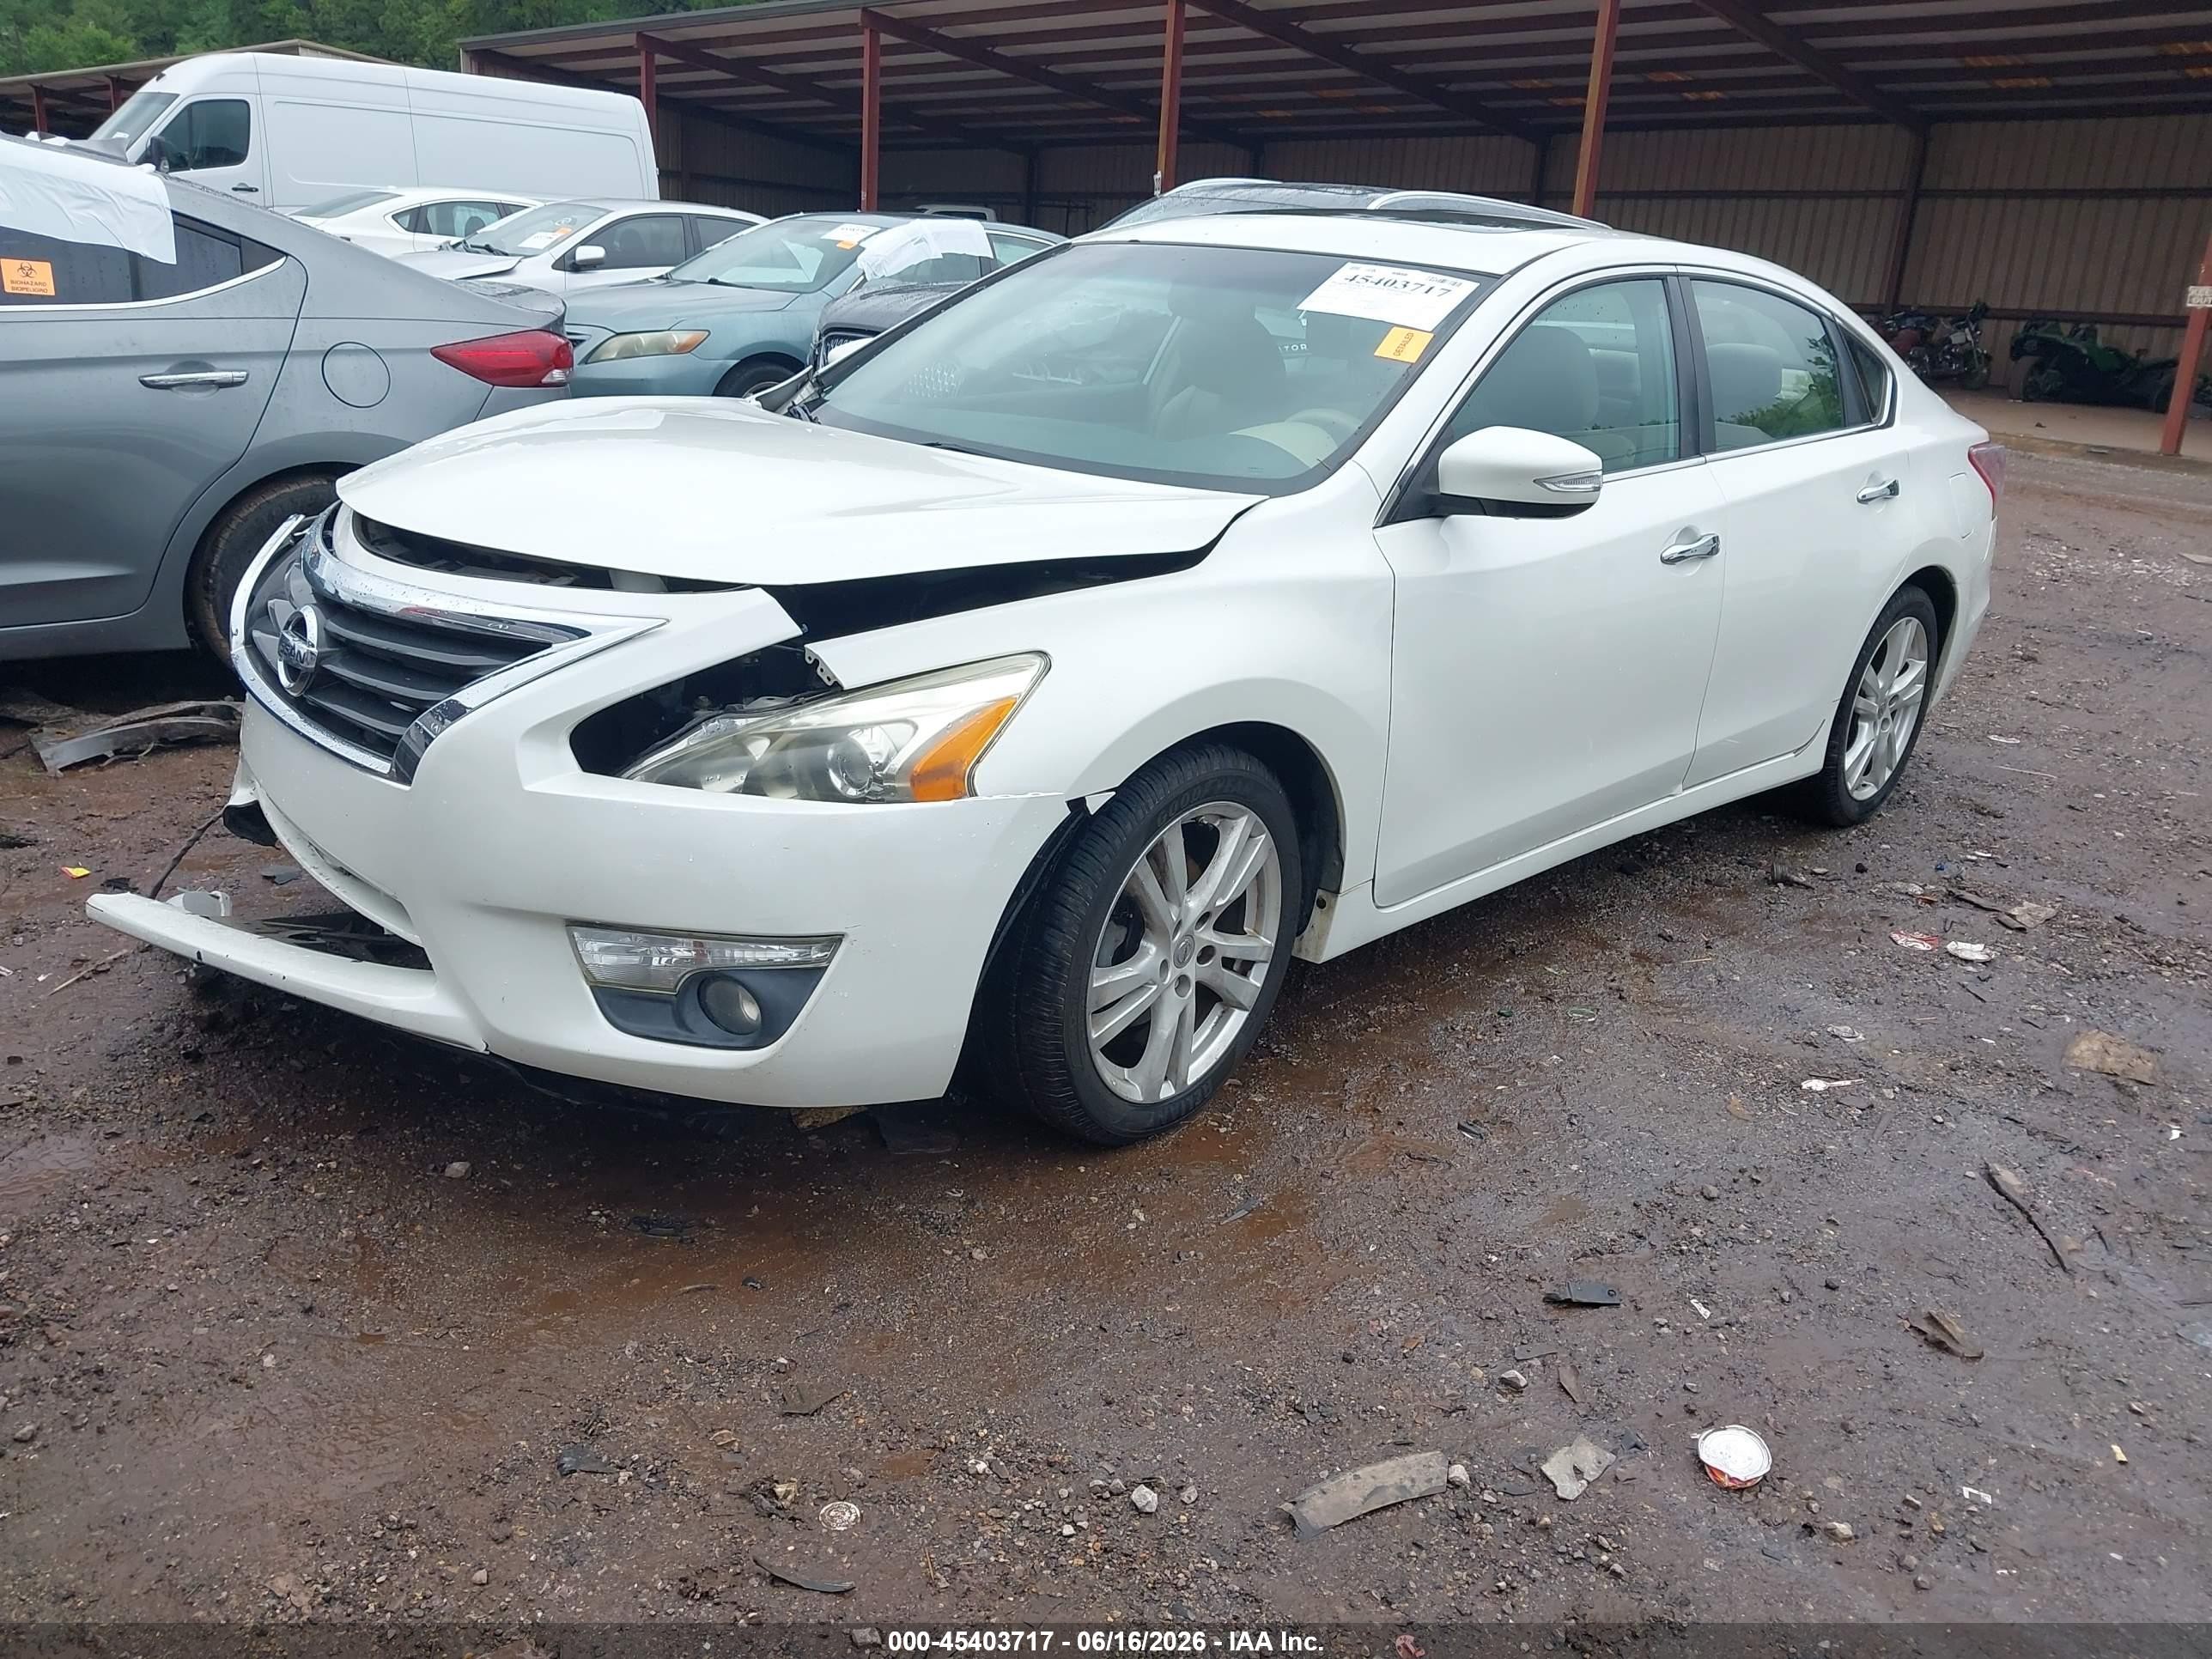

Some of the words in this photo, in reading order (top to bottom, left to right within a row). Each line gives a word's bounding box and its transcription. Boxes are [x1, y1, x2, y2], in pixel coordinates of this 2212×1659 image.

[1344, 274, 1453, 297] 45403717
[2190, 287, 2212, 296] KEE
[1393, 331, 1415, 357] DETAILED
